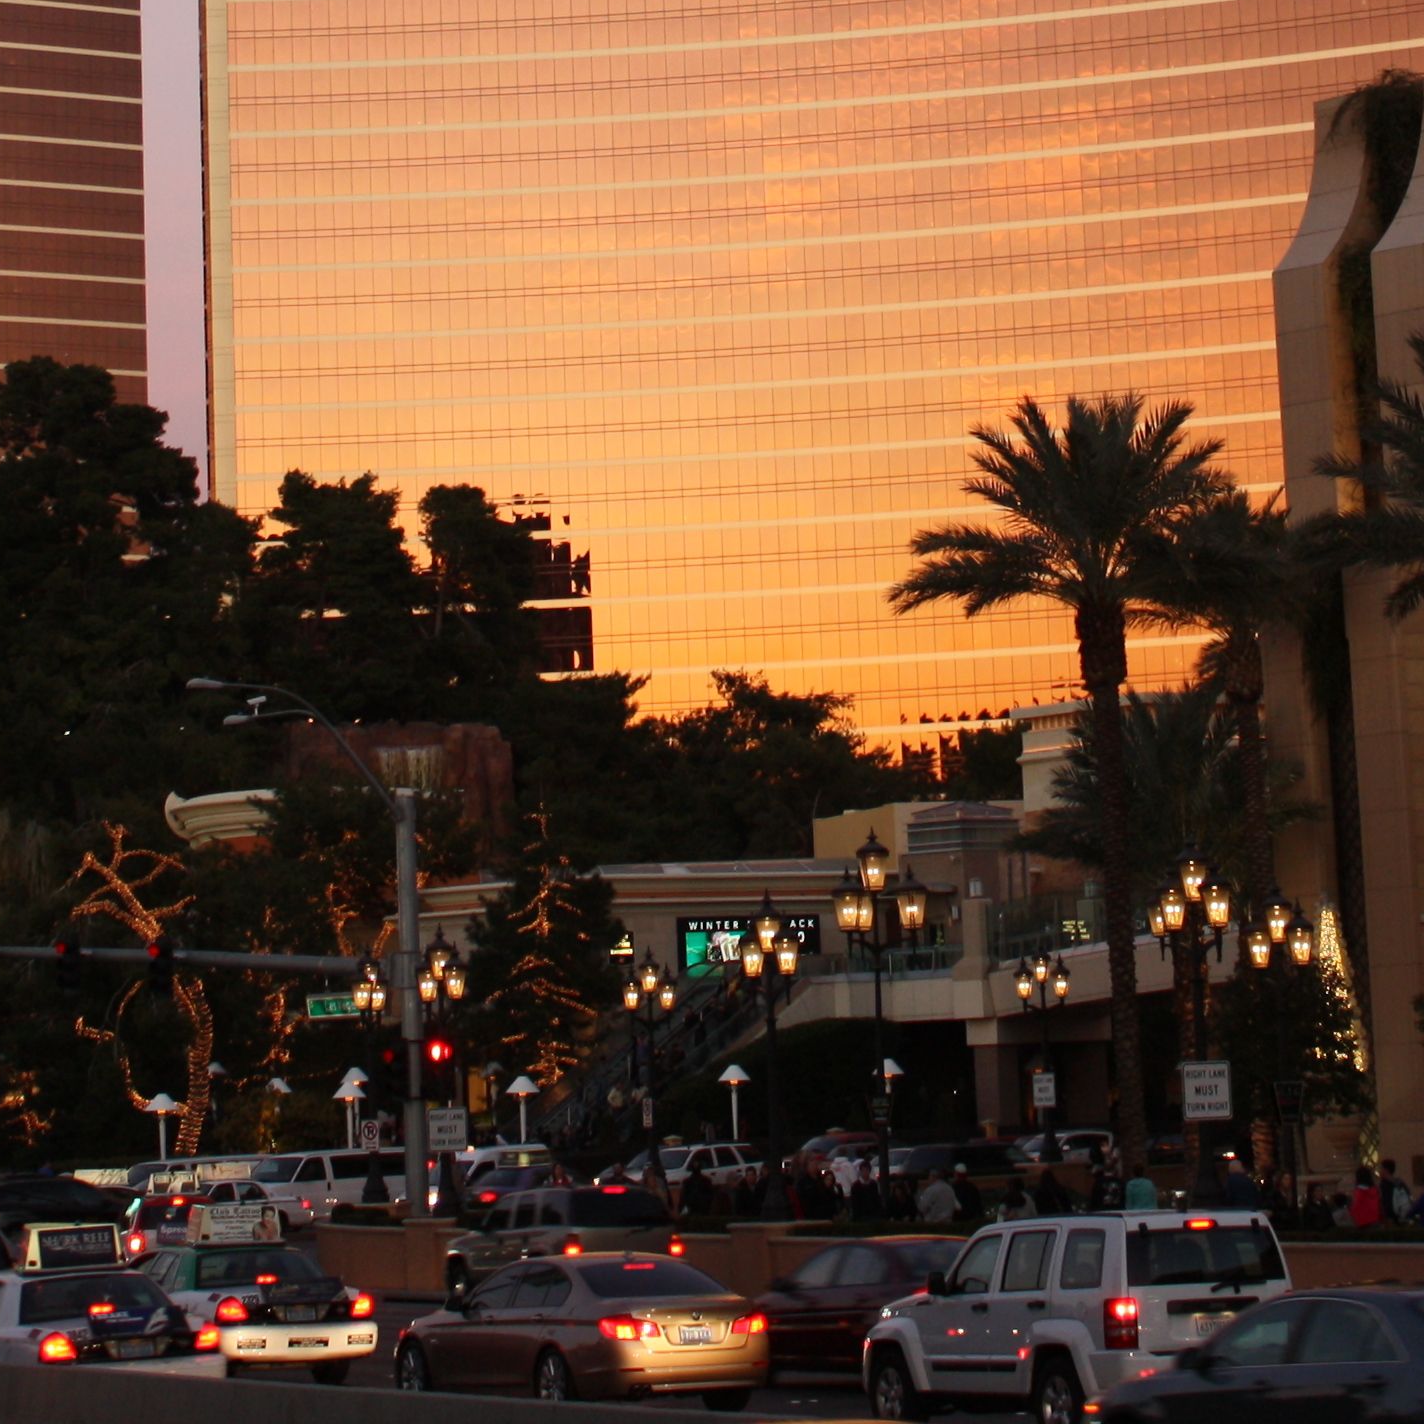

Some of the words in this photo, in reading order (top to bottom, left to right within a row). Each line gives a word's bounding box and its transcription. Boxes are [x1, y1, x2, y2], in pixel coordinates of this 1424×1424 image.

[688, 921, 739, 931] WINTER
[1208, 1069, 1226, 1078] LANE
[1194, 1085, 1219, 1095] MUST
[1187, 1103, 1206, 1112] TURN
[210, 1206, 230, 1216] Club
[83, 1231, 110, 1243] REEF
